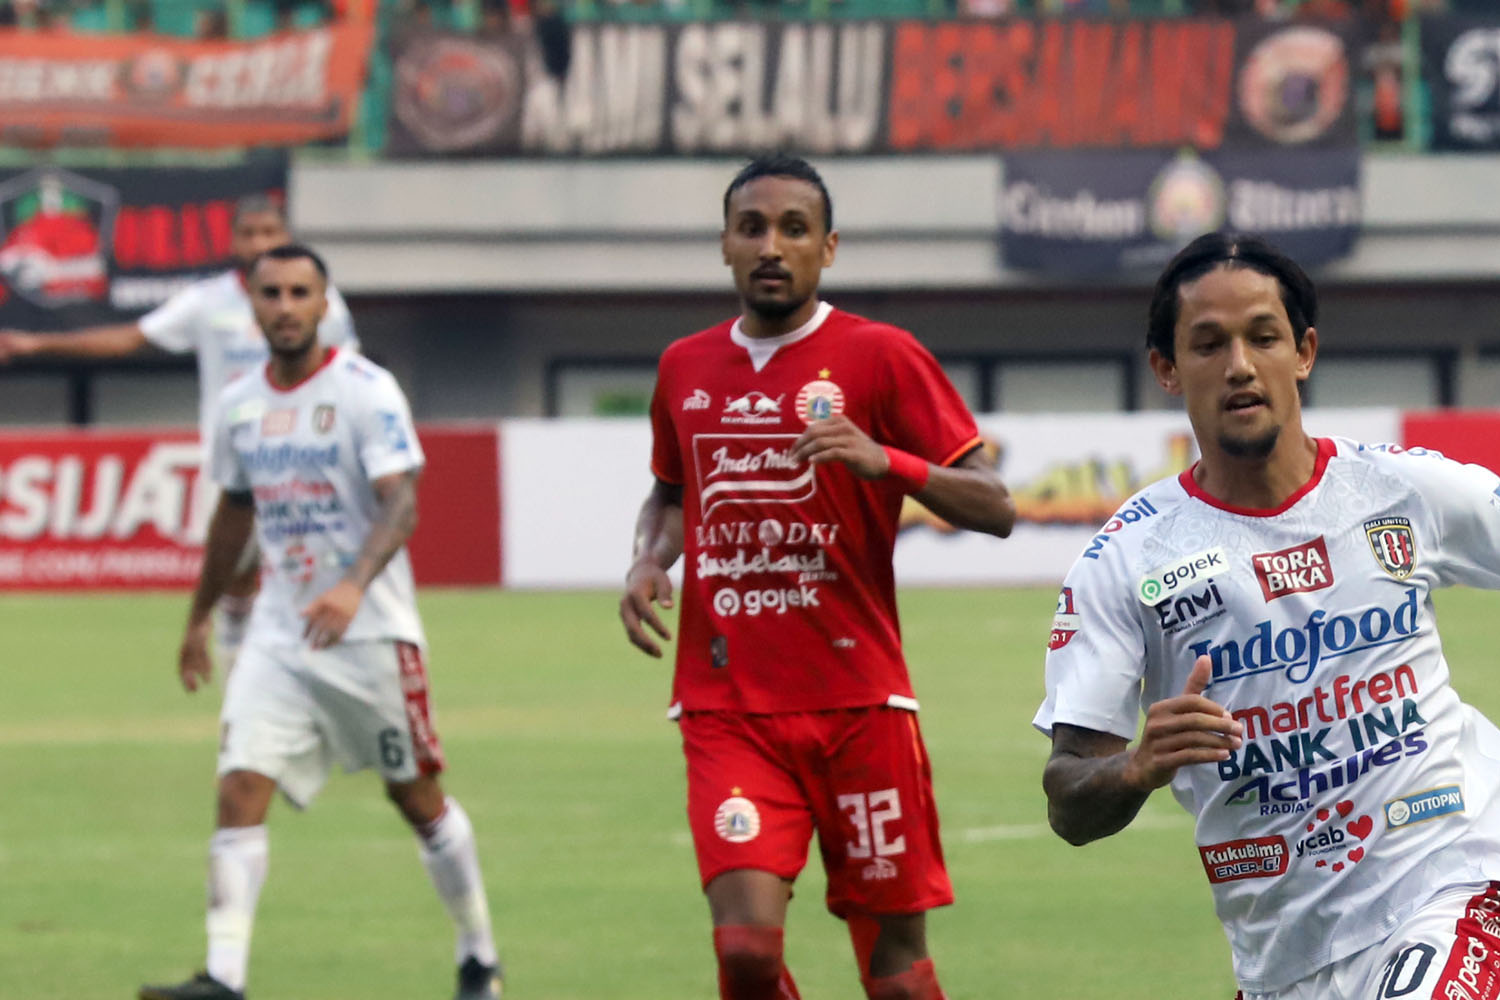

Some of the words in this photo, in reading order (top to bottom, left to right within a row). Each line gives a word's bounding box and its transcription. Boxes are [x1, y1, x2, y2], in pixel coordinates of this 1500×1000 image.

[696, 522, 755, 546] BANK
[785, 522, 840, 545] DKI
[1082, 497, 1158, 560] Mobil
[1365, 520, 1381, 530] BALI
[1382, 517, 1409, 527] UNITED
[1163, 552, 1223, 590] gojek
[1255, 547, 1325, 573] TORA
[1267, 565, 1328, 594] BIKA
[743, 583, 820, 616] gojek
[1154, 577, 1224, 630] Envi
[1189, 587, 1420, 684] Indofood
[1231, 663, 1418, 740] martfren
[377, 727, 406, 769] 6
[1217, 726, 1338, 782] BANK
[1347, 698, 1428, 752] INA
[1260, 801, 1315, 817] RADIAL
[1411, 790, 1463, 816] OTTOPAY
[837, 787, 906, 859] 32
[1205, 841, 1285, 866] KukuBima
[1296, 825, 1345, 858] ycab
